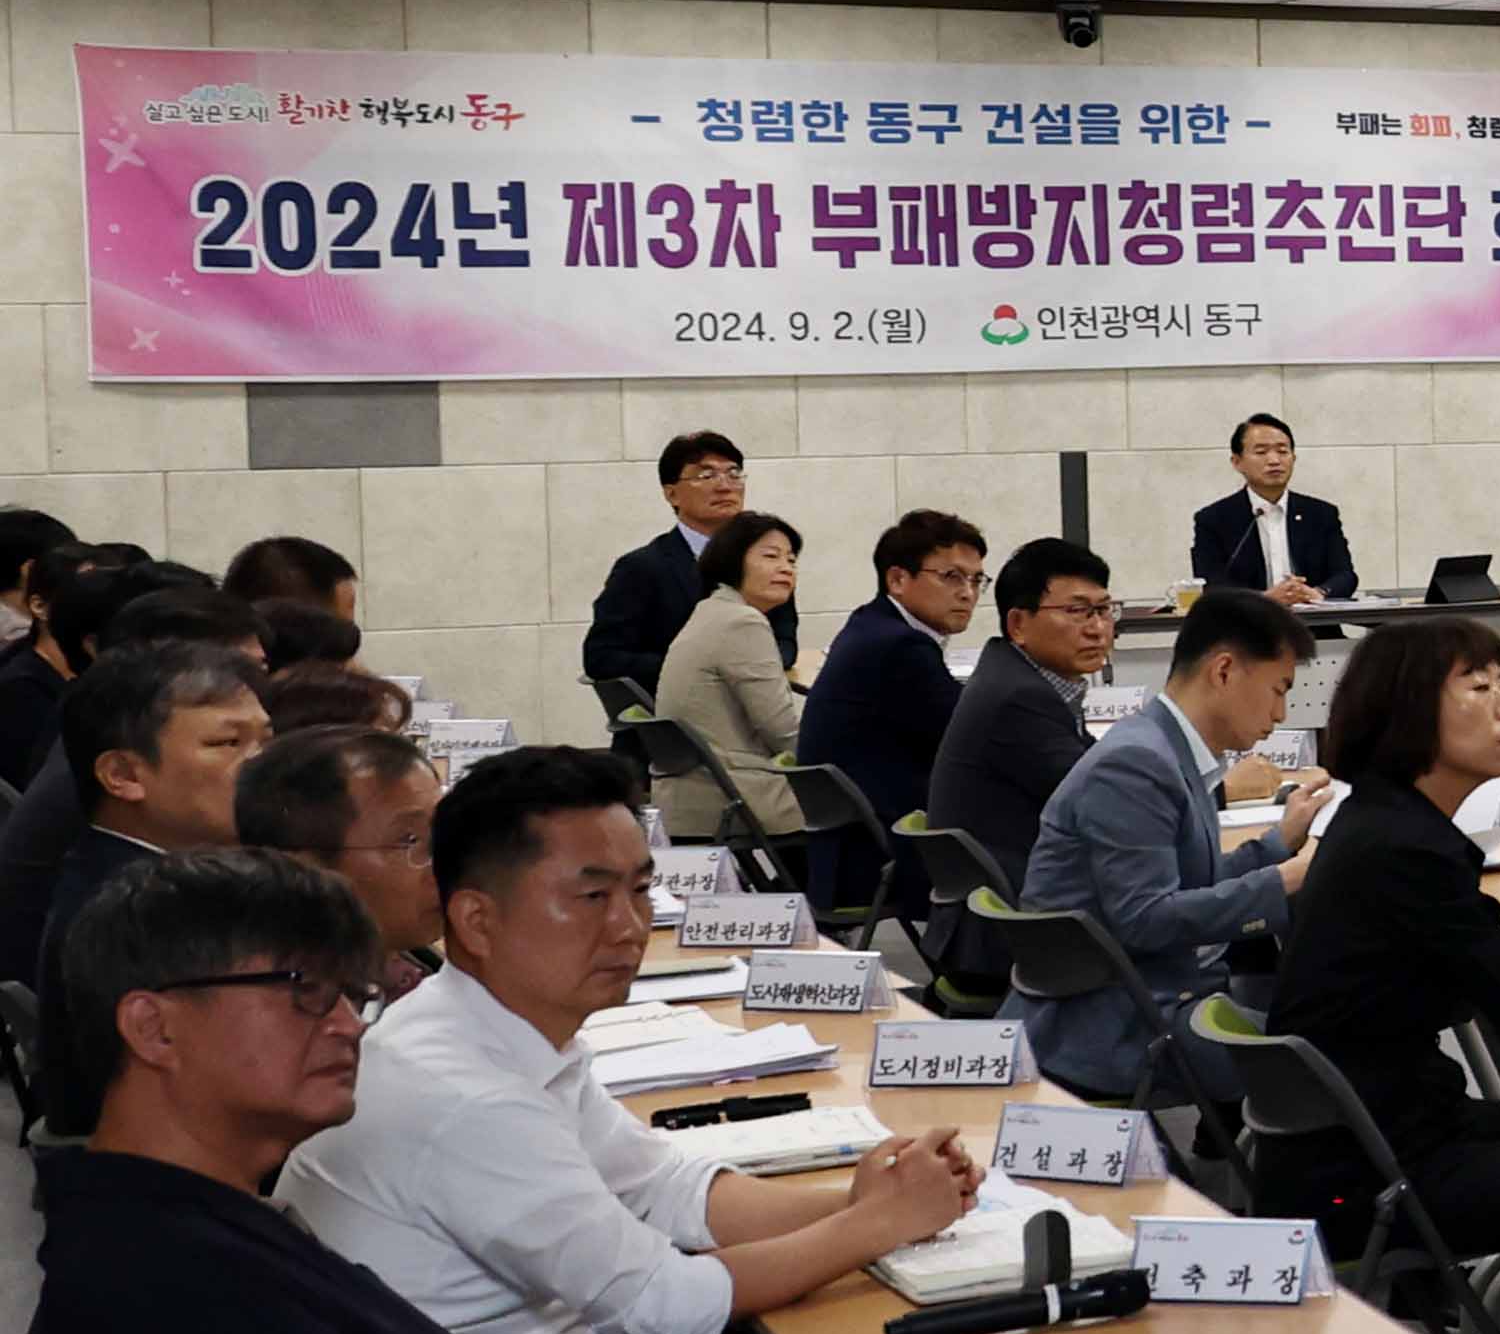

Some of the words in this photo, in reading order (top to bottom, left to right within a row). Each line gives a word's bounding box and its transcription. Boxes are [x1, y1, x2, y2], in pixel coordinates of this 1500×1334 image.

[187, 104, 221, 123] 싶은
[277, 93, 350, 125] 활기찬
[359, 97, 455, 129] 행복도시
[460, 93, 526, 131] 동구
[697, 98, 848, 145] 청렴한
[866, 100, 963, 146] 동구
[981, 102, 1121, 147] 건설을
[1138, 102, 1229, 147] 위한
[1336, 112, 1402, 136] 부패는
[1410, 113, 1460, 140] 회피,
[198, 179, 532, 270] 2024년
[562, 179, 781, 270] 제3차
[811, 180, 1467, 269] 부패방지청렴추진단
[675, 310, 776, 343] 2024.
[1036, 305, 1193, 342] 인천광역시
[1204, 303, 1263, 338] 동구
[686, 921, 793, 941] 안전관리과장
[875, 1054, 1010, 1078] 도시정비과장
